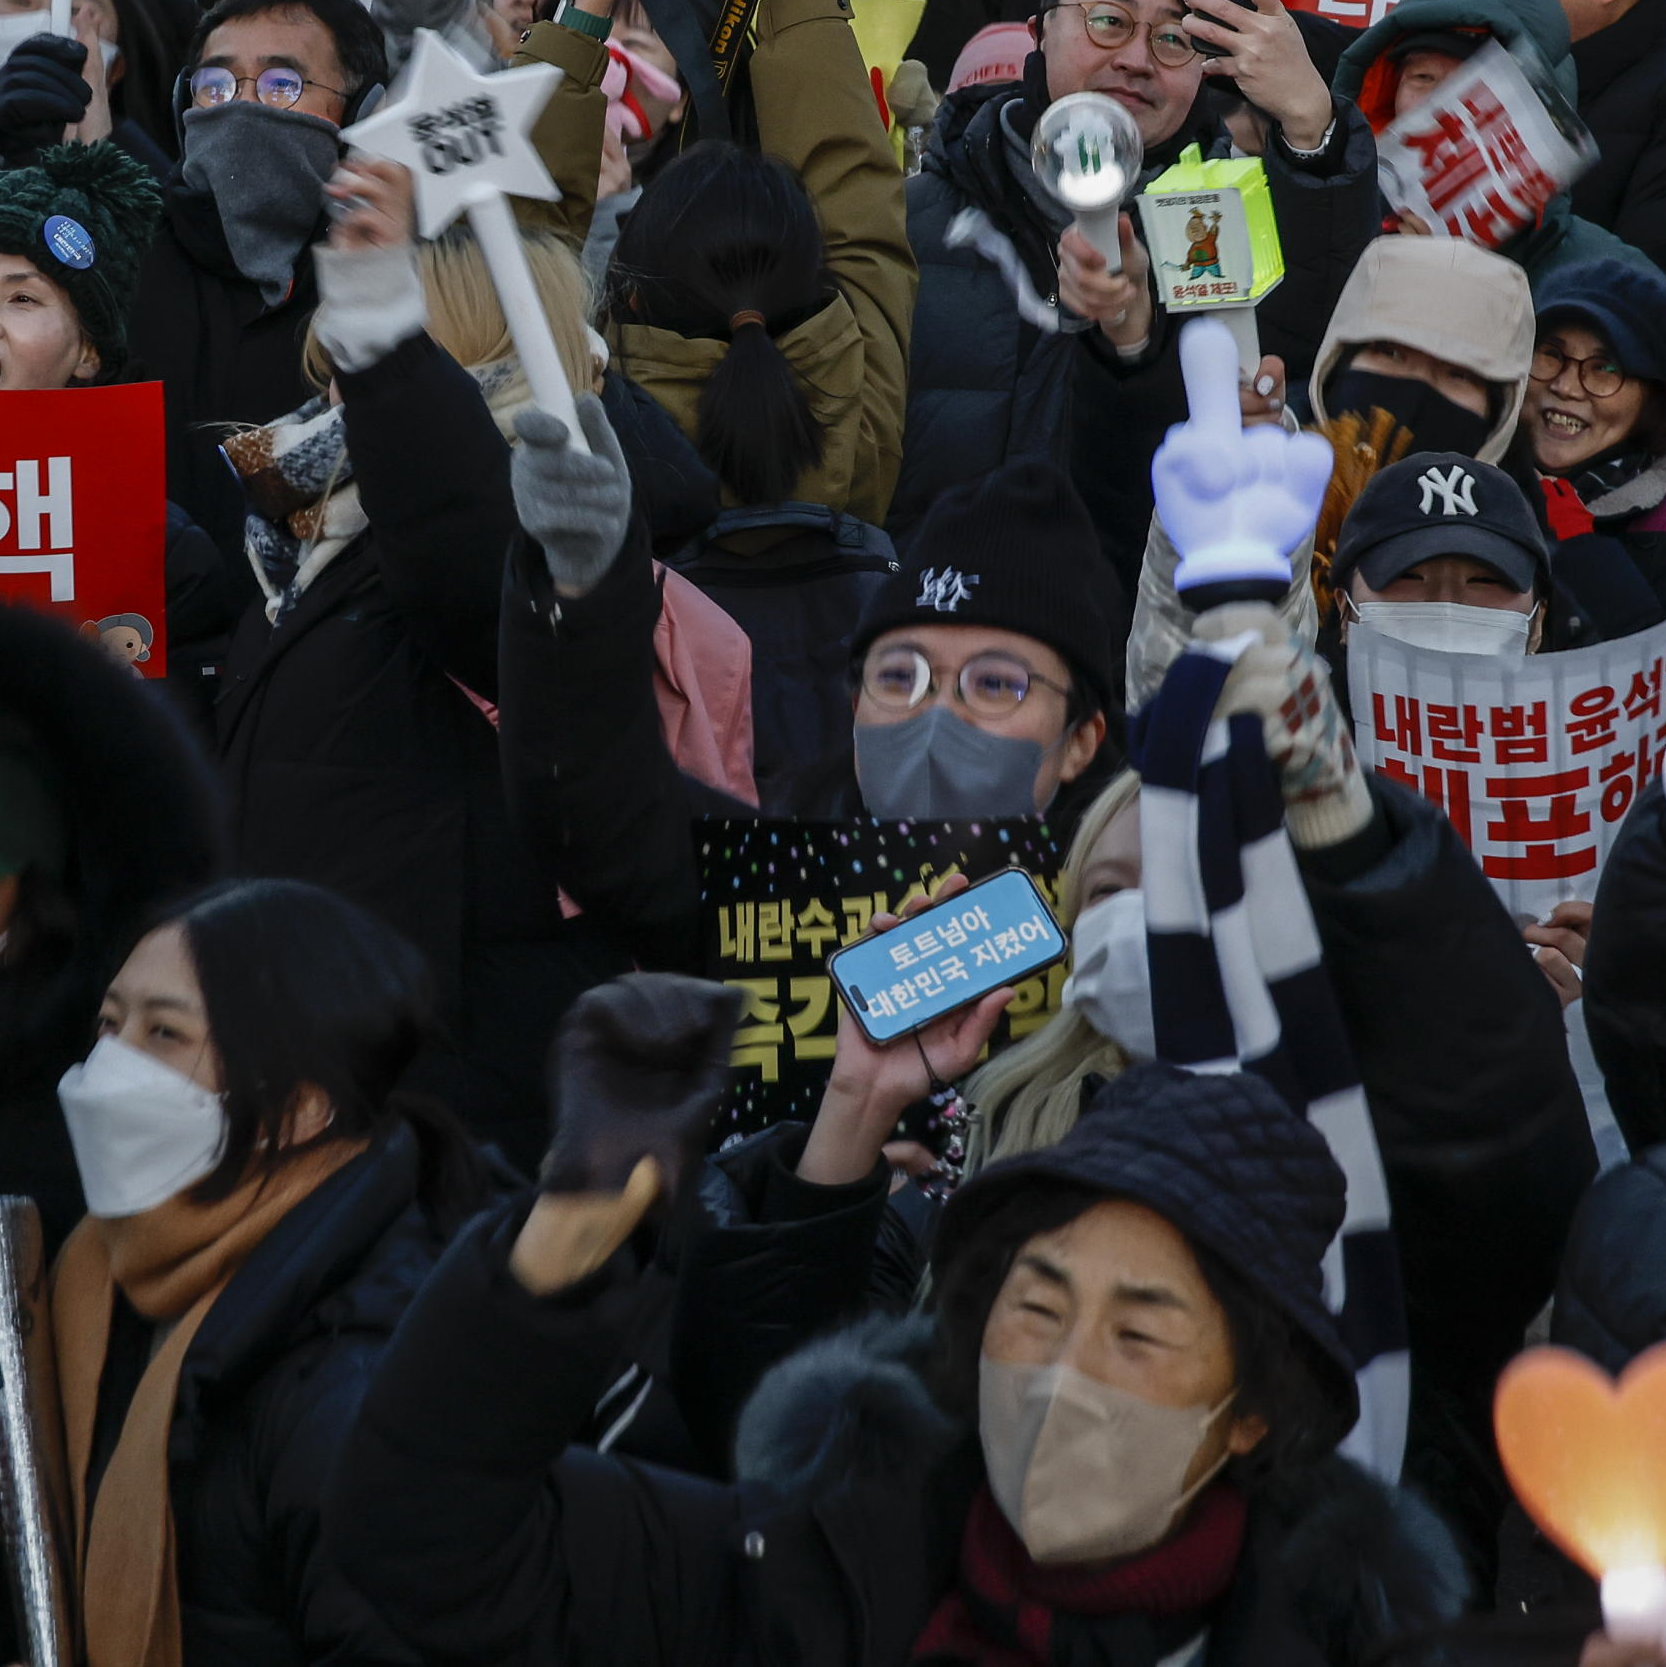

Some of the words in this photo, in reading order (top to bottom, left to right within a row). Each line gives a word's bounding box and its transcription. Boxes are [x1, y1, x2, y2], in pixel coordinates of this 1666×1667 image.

[1417, 464, 1479, 517] NY
[1373, 691, 1547, 764] 내란범
[866, 957, 970, 1020] 대한민국
[974, 913, 1052, 971] 지켰어
[889, 904, 992, 972] 토트넘아
